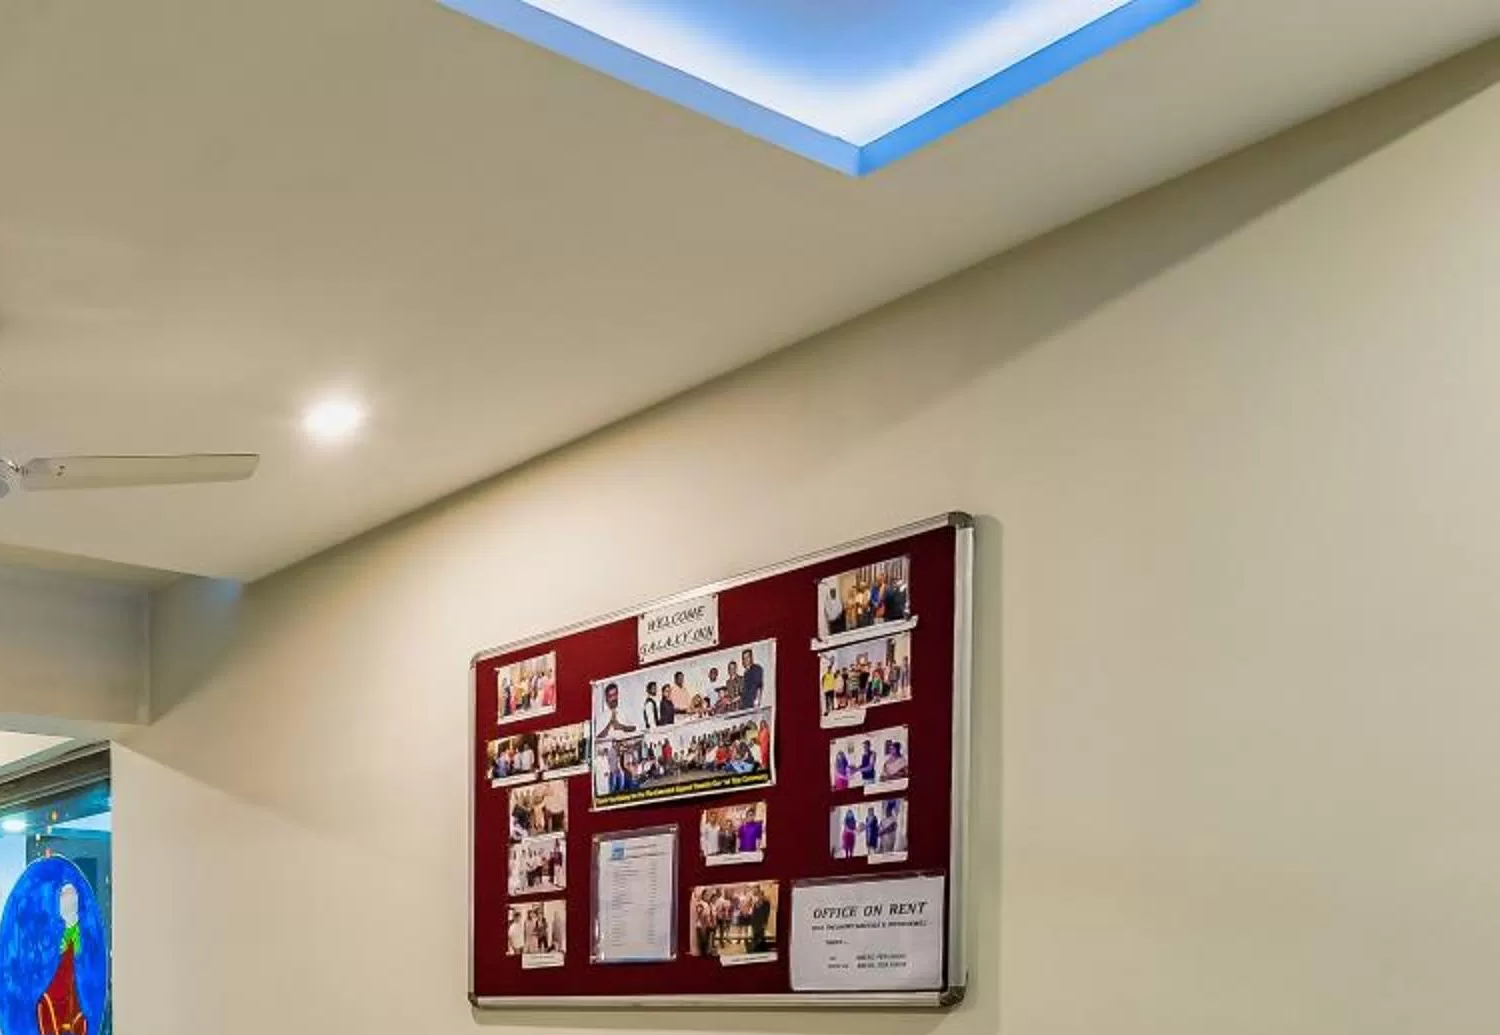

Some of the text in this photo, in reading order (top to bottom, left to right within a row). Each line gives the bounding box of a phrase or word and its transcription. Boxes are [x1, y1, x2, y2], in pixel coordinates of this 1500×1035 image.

[647, 605, 705, 633] WELCOME
[813, 901, 928, 919] OFFICE ON RENT
